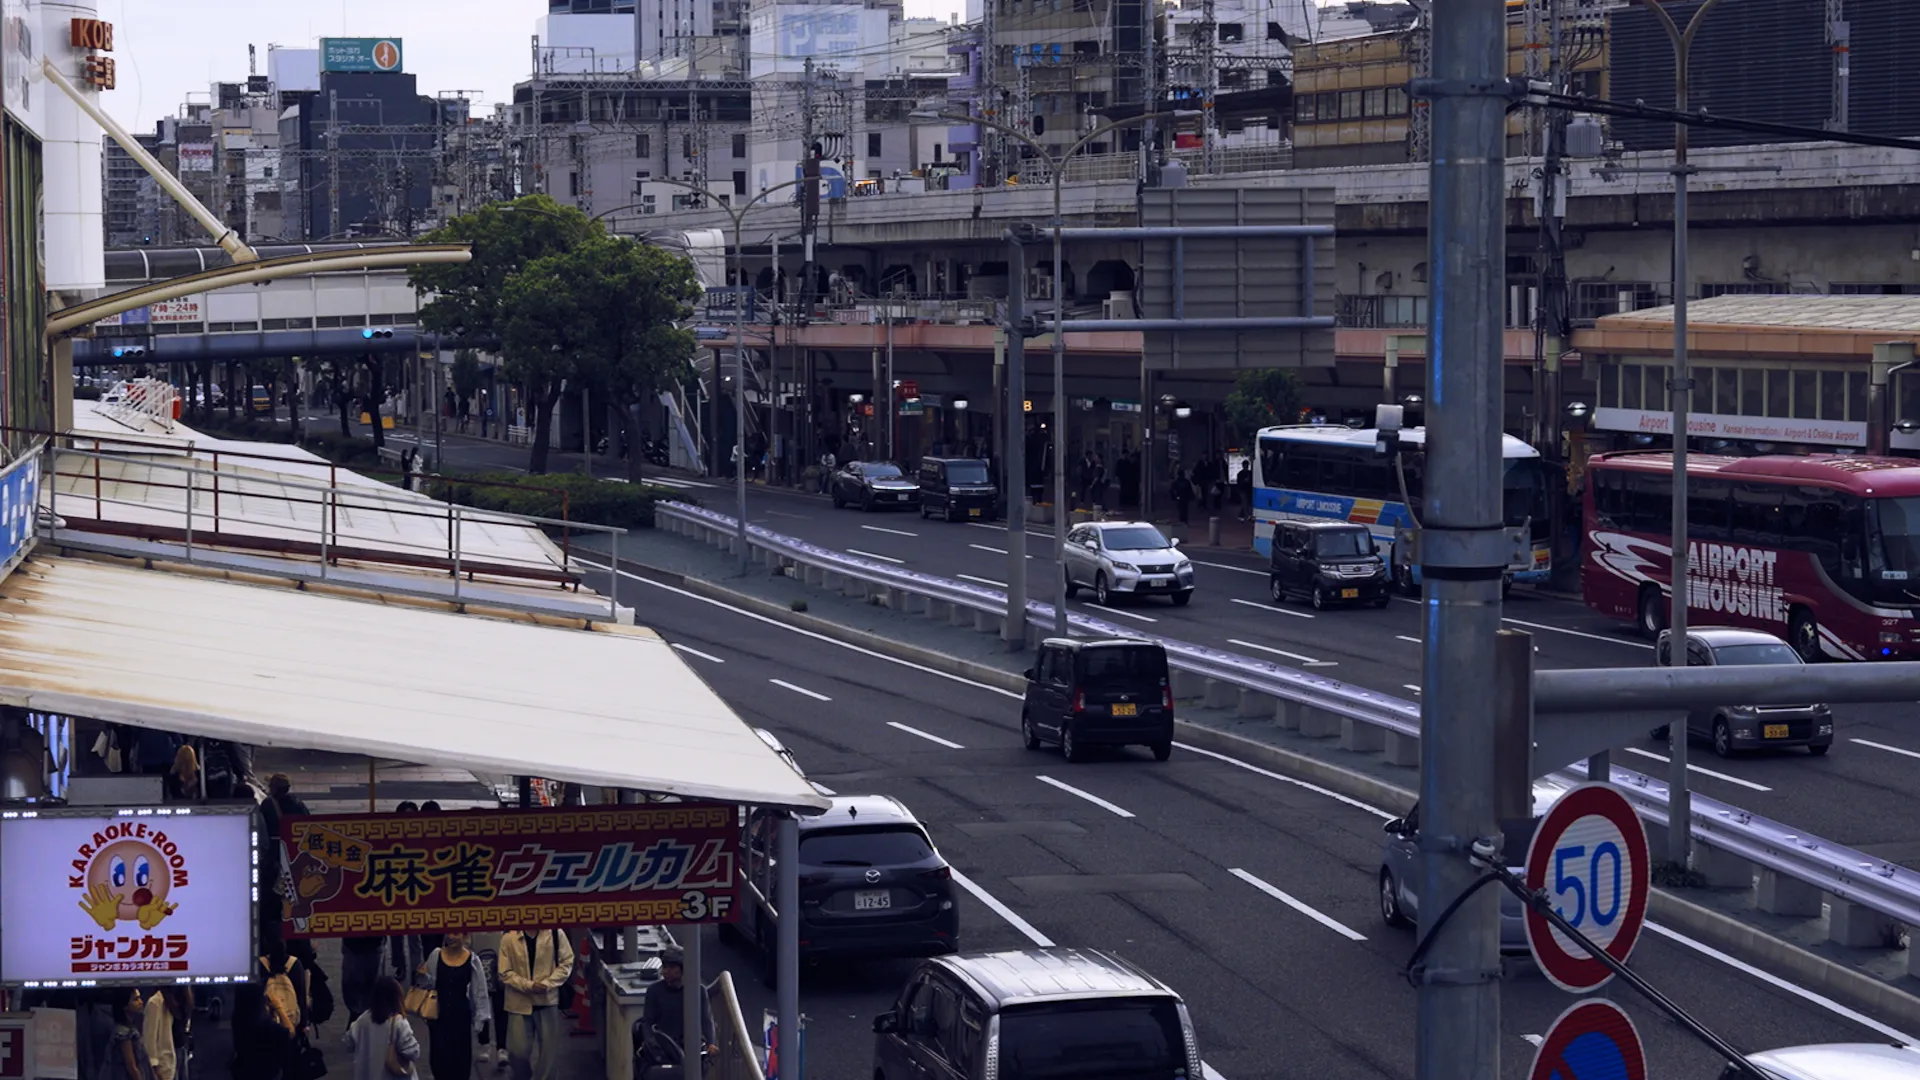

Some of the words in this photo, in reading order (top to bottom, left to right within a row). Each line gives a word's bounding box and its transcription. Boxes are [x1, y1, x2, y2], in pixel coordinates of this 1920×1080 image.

[1639, 415, 1668, 431] Airport
[1687, 418, 1716, 432] ousine
[1784, 427, 1806, 440] Airport
[1813, 428, 1833, 439] Osaka
[1835, 429, 1860, 442] Airport
[1296, 499, 1315, 510] AIRPORT
[1316, 500, 1342, 514] LIMOUSINE
[1687, 542, 1776, 585] AIRPORT
[1687, 576, 1783, 622] IMOUSINE
[307, 834, 362, 863] 低料金
[1555, 841, 1621, 927] 50
[681, 890, 732, 920] 3F
[71, 935, 188, 960] ジャンカラ
